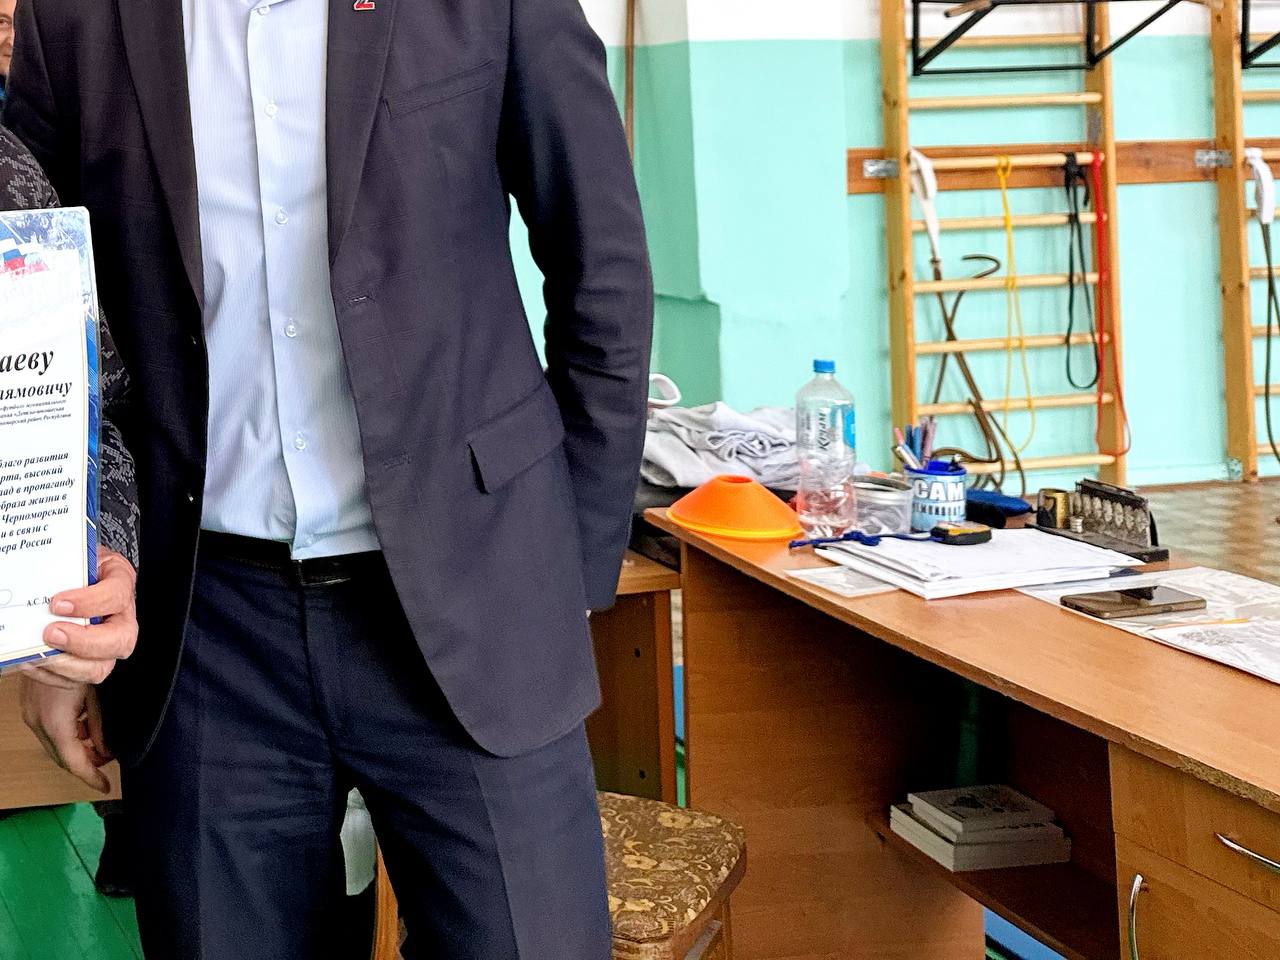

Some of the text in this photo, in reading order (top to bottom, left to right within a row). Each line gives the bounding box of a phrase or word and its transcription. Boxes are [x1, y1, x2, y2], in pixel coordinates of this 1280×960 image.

[24, 452, 69, 468] развития
[24, 465, 64, 479] высокий
[24, 477, 75, 495] пропаганду
[28, 494, 59, 507] жизни
[62, 493, 67, 501] в
[2, 505, 69, 525] Черноморский
[1, 531, 7, 539] и
[16, 526, 41, 536] связи
[20, 537, 52, 550] России
